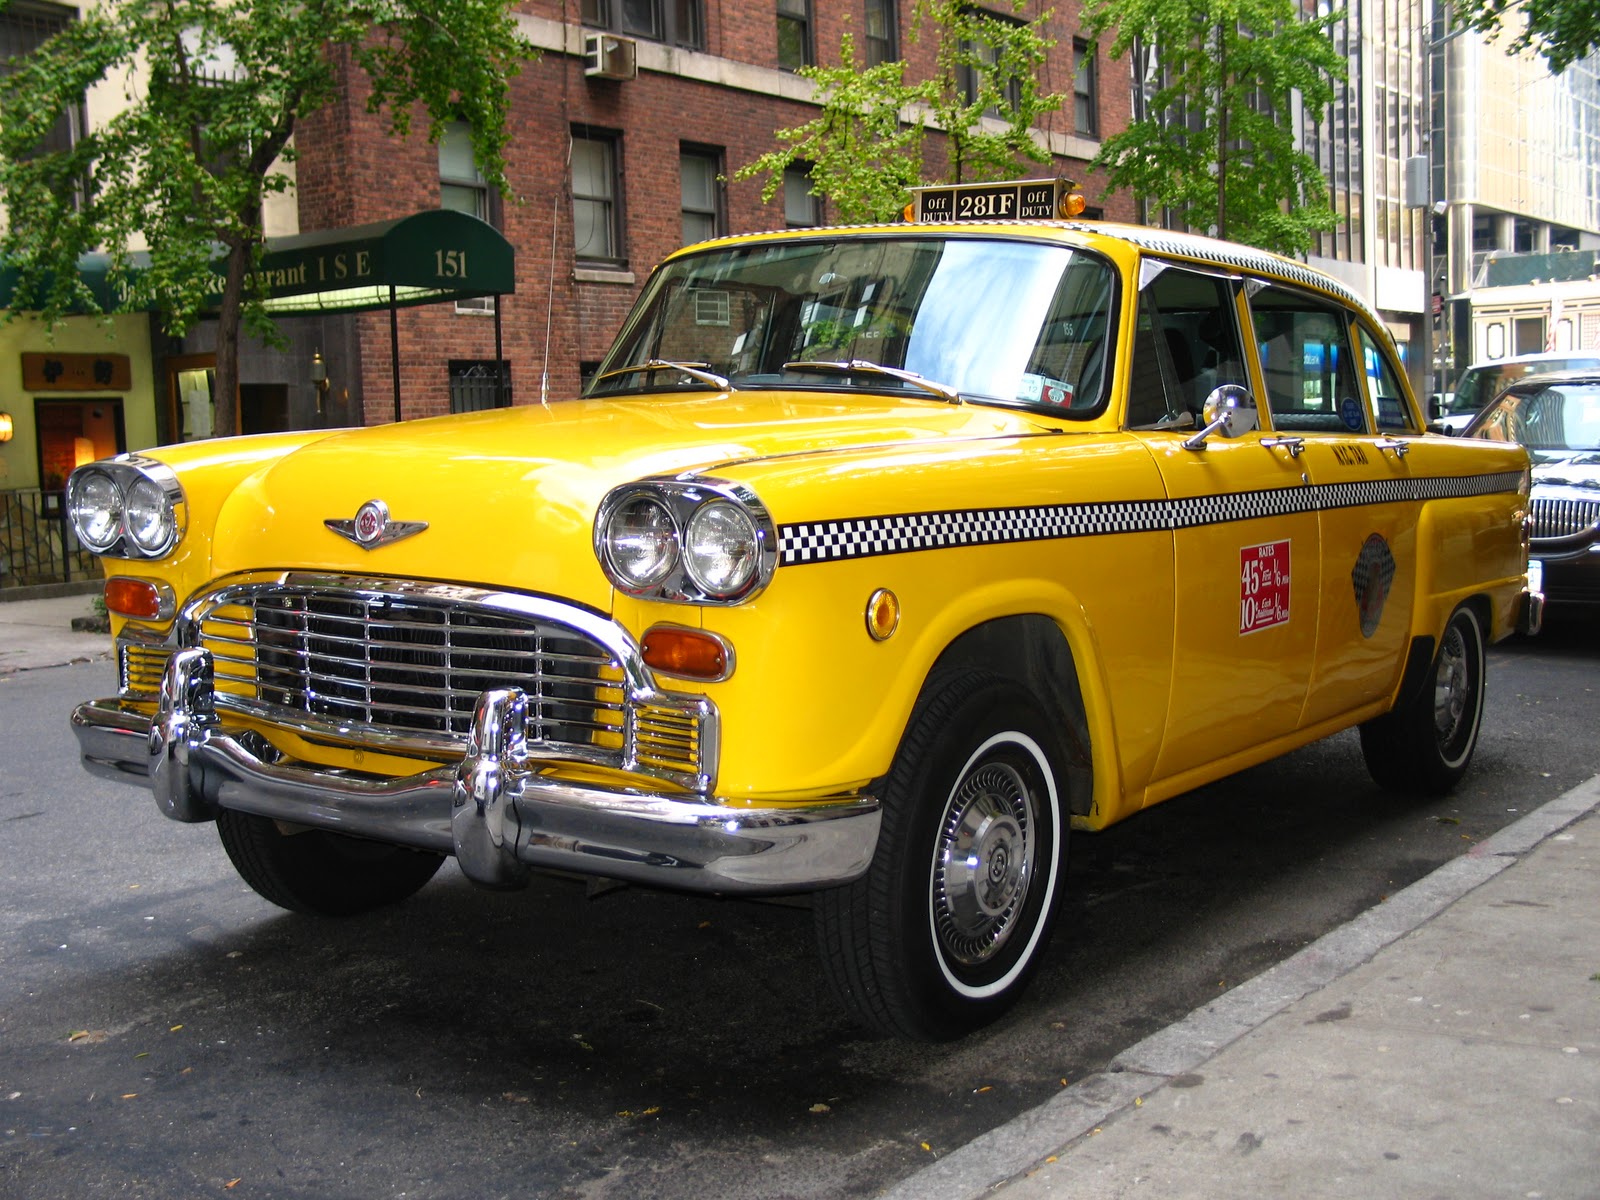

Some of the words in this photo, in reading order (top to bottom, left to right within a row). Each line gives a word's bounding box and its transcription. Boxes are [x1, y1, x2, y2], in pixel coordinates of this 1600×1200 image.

[923, 212, 952, 222] DUTY
[1021, 205, 1052, 217] DUTY
[434, 248, 467, 279] 151
[1258, 545, 1275, 558] RATES
